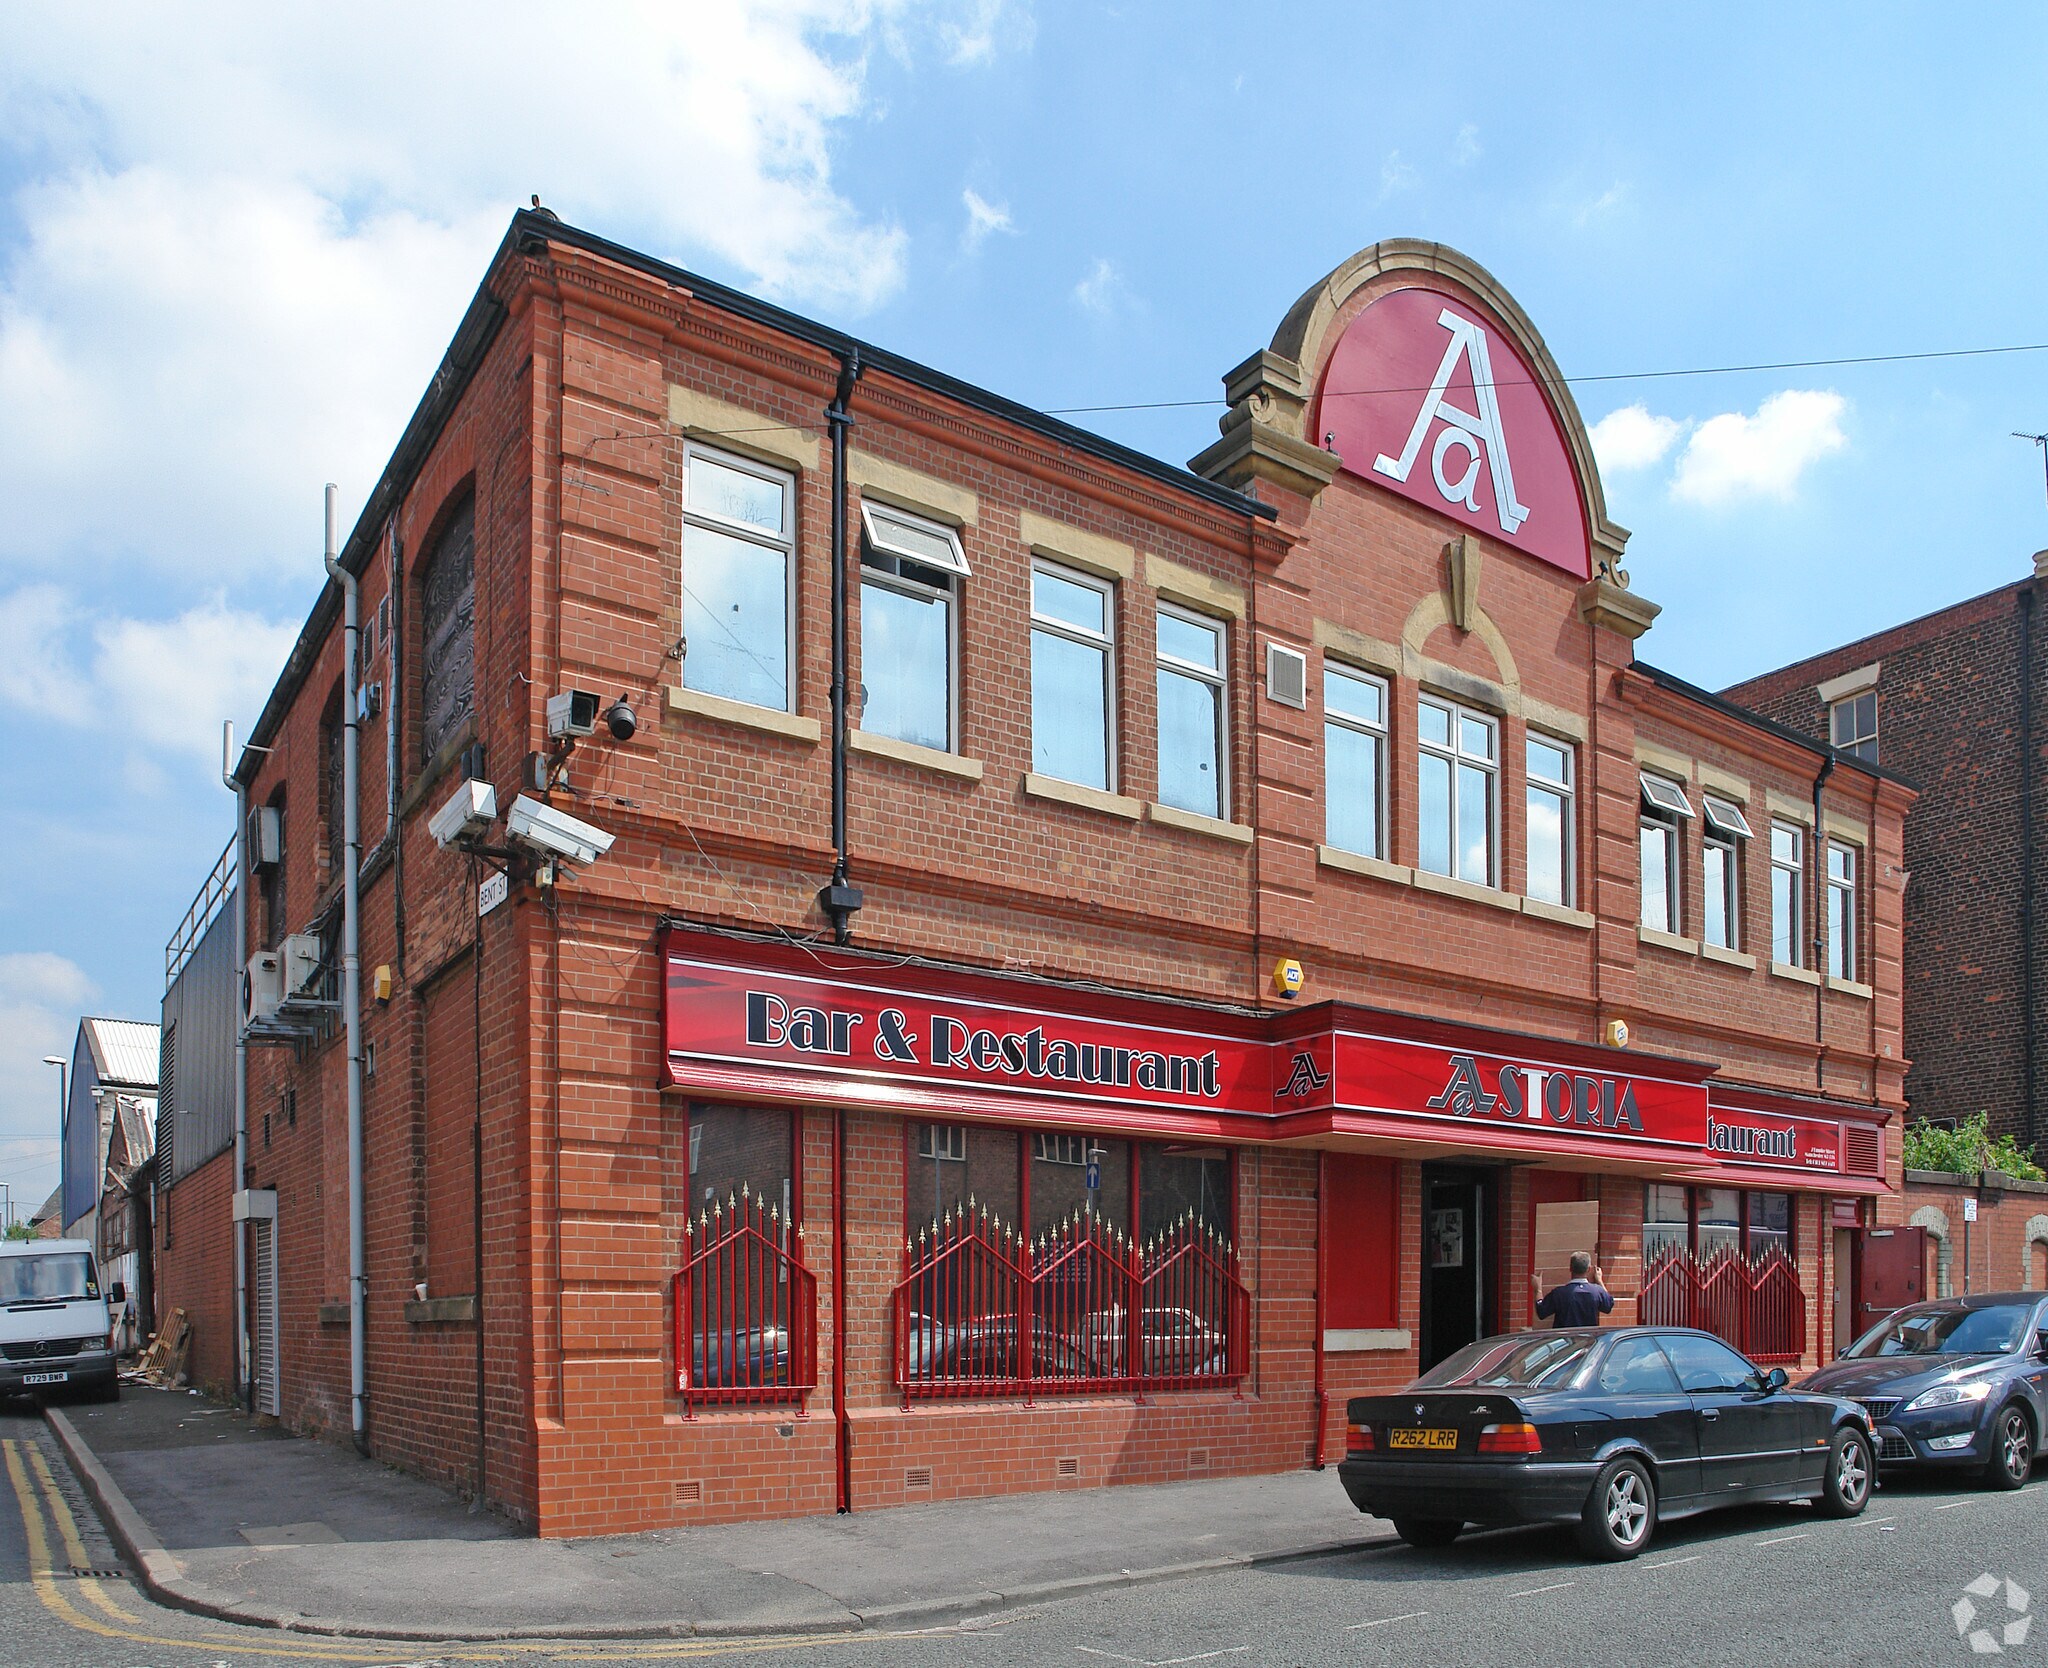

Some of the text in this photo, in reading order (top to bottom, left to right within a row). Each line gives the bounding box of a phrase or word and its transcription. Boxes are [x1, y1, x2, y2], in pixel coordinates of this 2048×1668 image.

[480, 882, 497, 908] BENT
[745, 989, 1221, 1098] Bar & Restaurant
[26, 1374, 47, 1383] R729
[1391, 1430, 1456, 1446] R262 LRR
